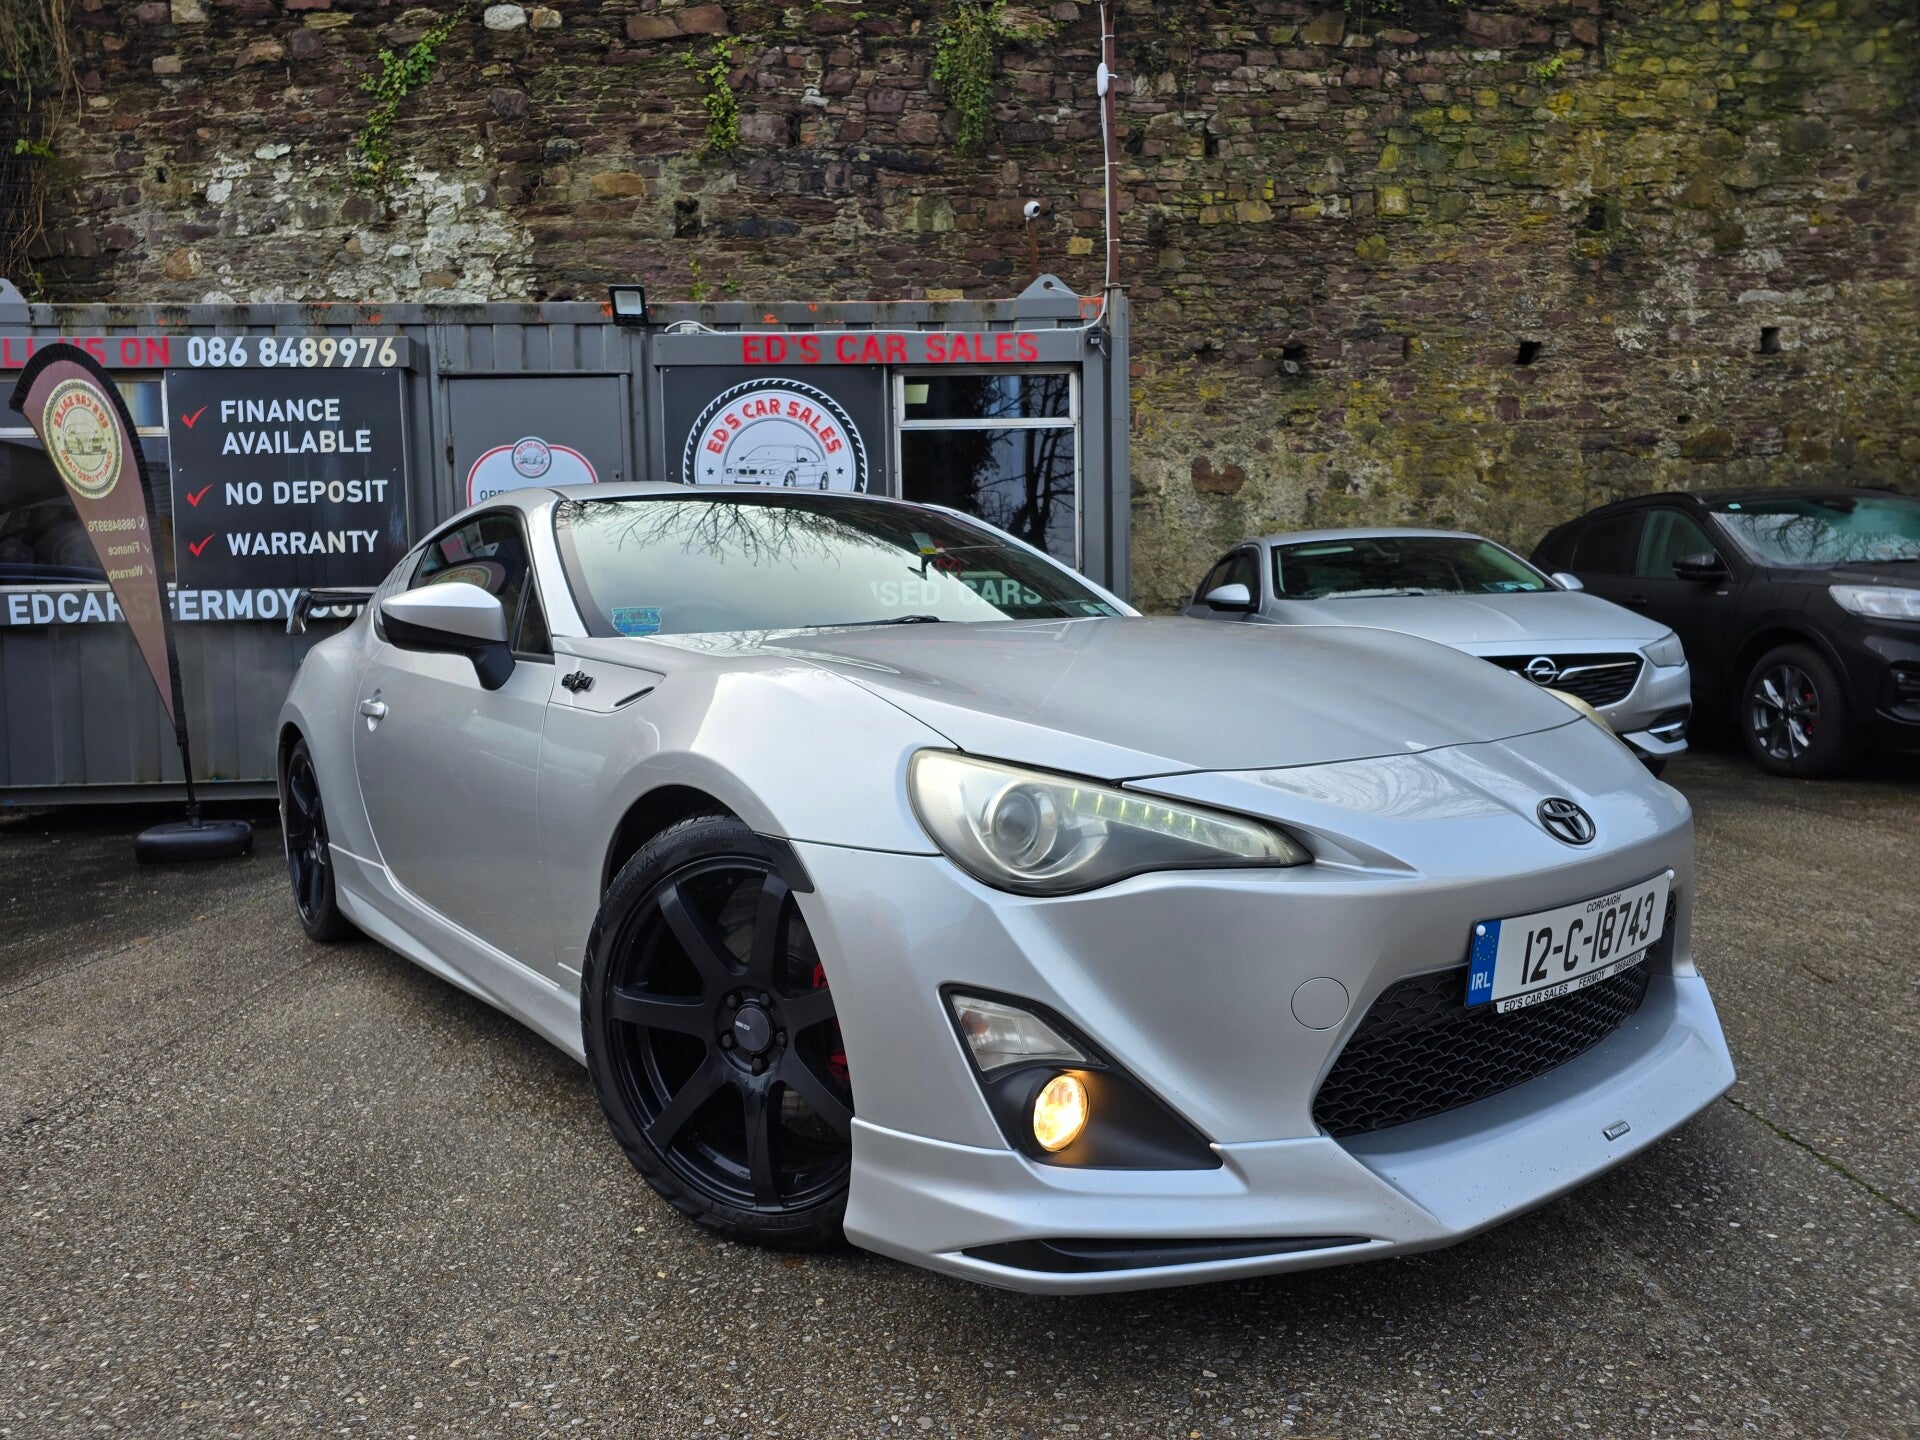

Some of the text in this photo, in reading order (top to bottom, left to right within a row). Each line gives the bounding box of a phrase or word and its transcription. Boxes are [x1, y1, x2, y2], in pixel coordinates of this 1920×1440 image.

[120, 336, 170, 367] ON
[187, 336, 398, 368] 086 8489976
[742, 332, 1039, 364] ED'S CAR SALES
[220, 398, 341, 424] FINANCE
[706, 398, 843, 455] ED'S CAR SALES
[222, 429, 372, 456] AVAILABLE
[225, 479, 389, 506] NO DEPOSIT
[226, 530, 379, 557] WARRANTY
[870, 578, 1043, 607] SED CARS
[1586, 893, 1621, 913] CORCAIGH
[1521, 891, 1656, 985] 12-C-18743
[1471, 972, 1491, 991] IRL
[1504, 997, 1523, 1012] ED'S
[1525, 992, 1542, 1006] CAR
[1543, 984, 1568, 1000] SALES
[1578, 968, 1606, 989] FERMOY
